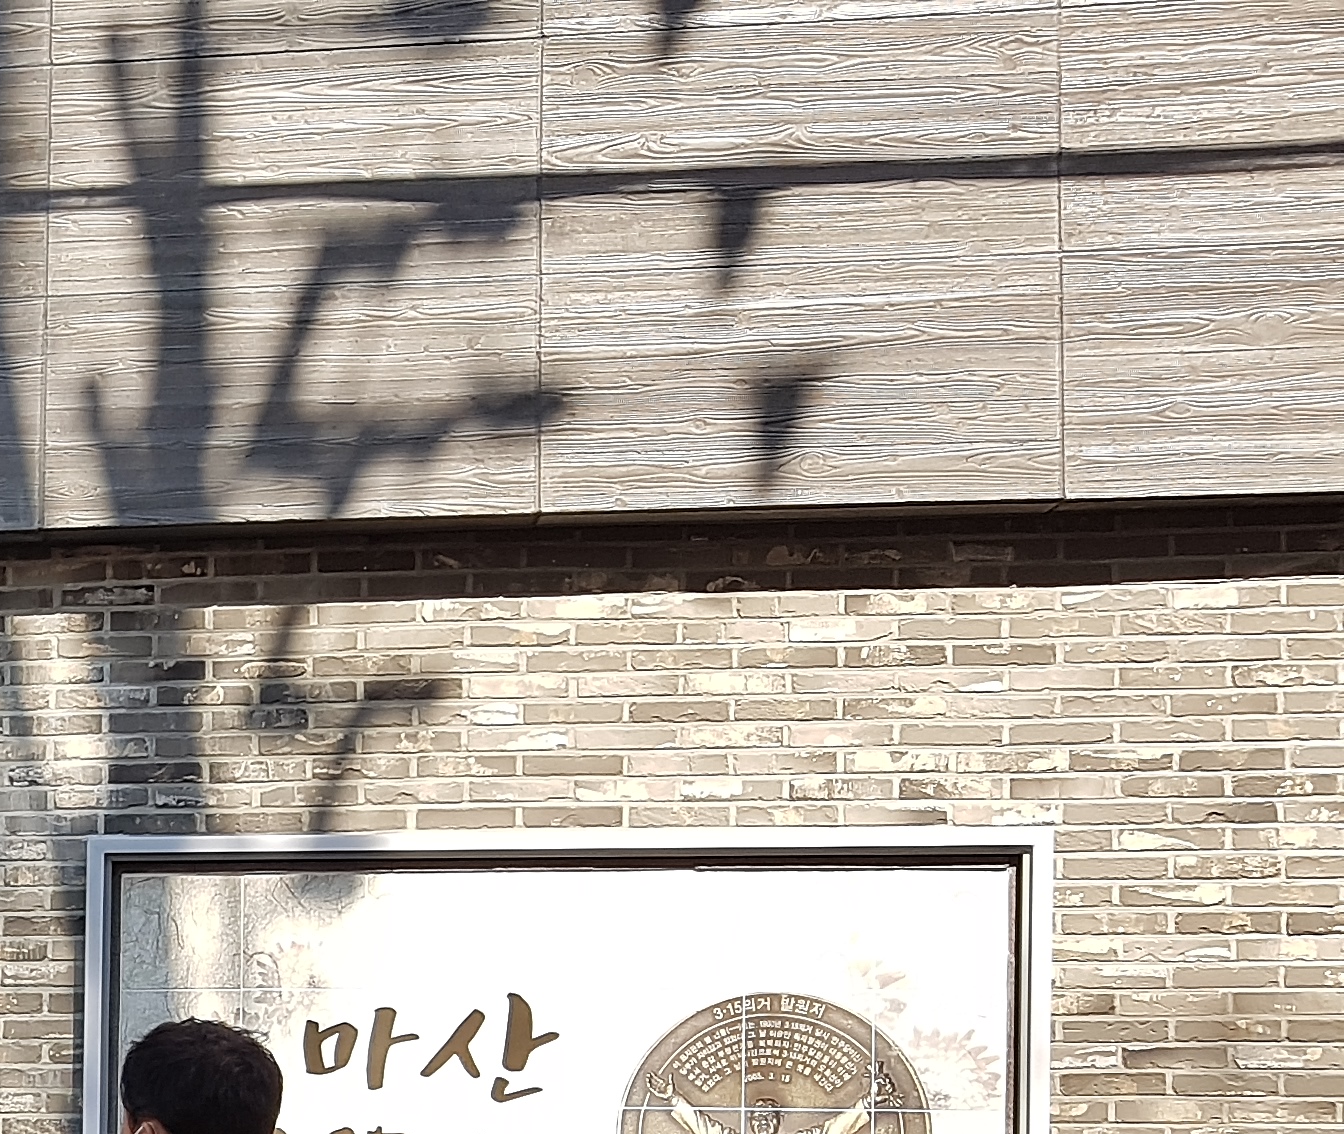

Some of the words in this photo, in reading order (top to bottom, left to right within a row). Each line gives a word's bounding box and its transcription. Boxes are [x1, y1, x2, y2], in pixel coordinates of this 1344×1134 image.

[713, 996, 772, 1021] 3·15의거
[780, 994, 828, 1019] 발원지
[302, 992, 560, 1103] 마산
